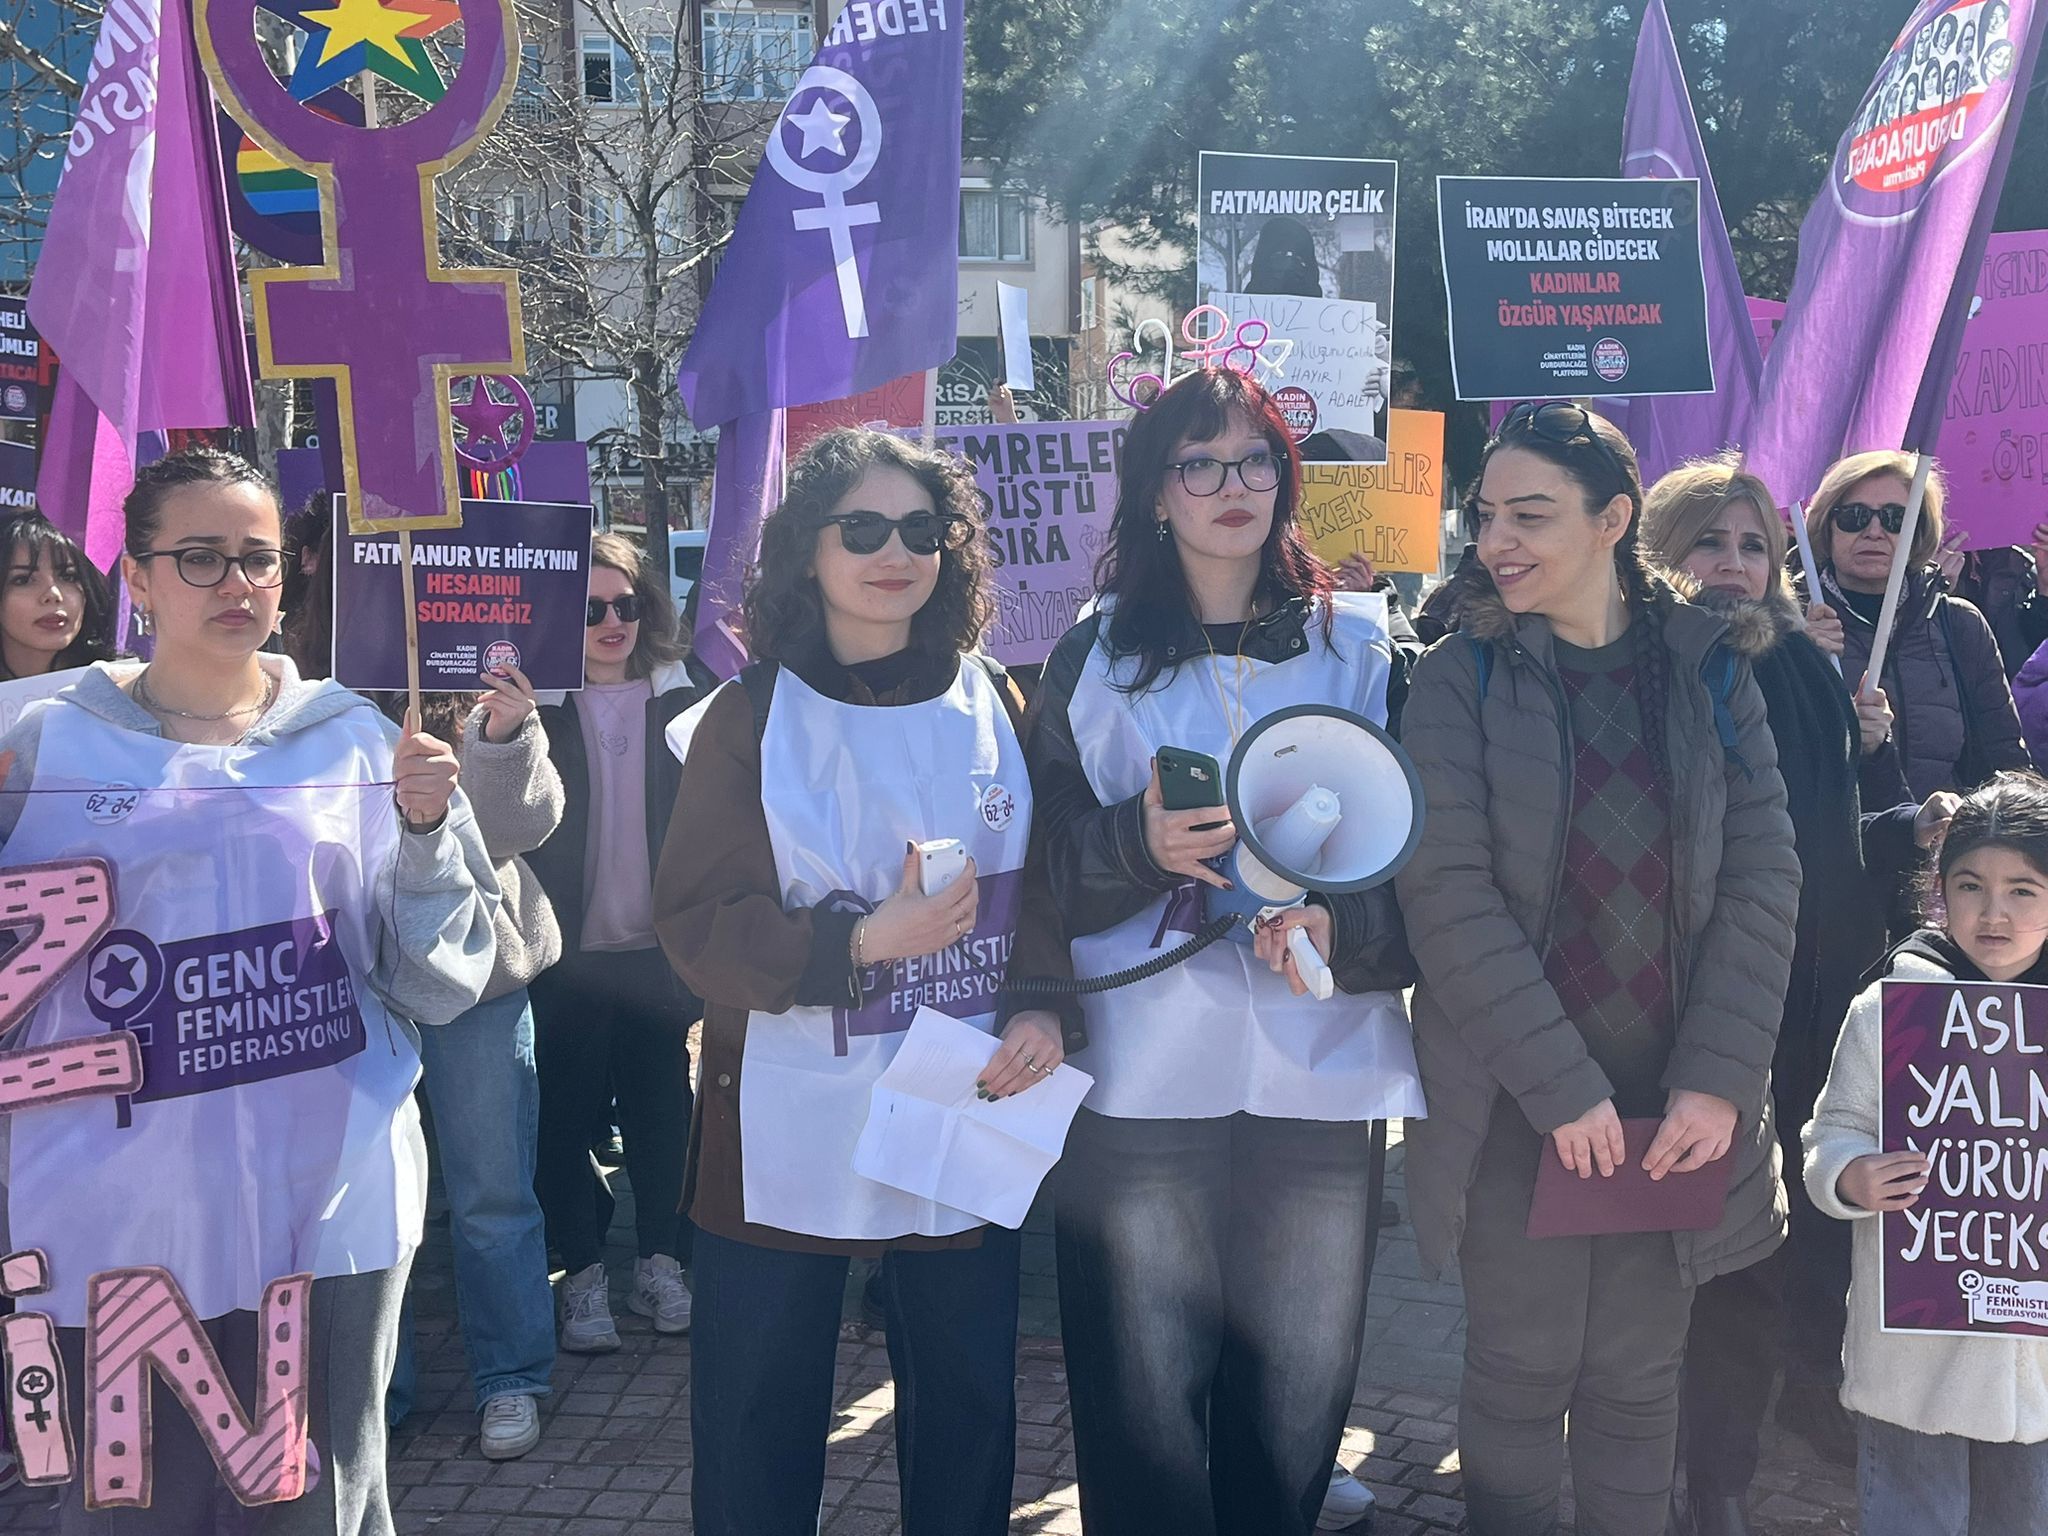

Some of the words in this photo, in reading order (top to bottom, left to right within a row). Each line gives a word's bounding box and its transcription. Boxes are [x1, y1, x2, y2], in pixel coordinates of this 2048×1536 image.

[1210, 190, 1323, 214] FATMANUR
[1325, 183, 1385, 220] ÇELİK
[1542, 206, 1600, 235] SAVAŞ
[1602, 201, 1674, 229] BİTECEK
[1487, 240, 1583, 262] MOLLALAR
[1585, 233, 1660, 261] GİDECEK
[1530, 272, 1621, 294] KADINLAR
[1498, 299, 1557, 326] ÖZGÜR
[1559, 304, 1662, 332] YAŞAYACAK
[1276, 393, 1307, 402] KADIN
[475, 546, 501, 569] VE
[426, 573, 521, 597] HESABINI
[418, 598, 532, 625] SORACAĞIZ
[174, 941, 297, 1003] GENÇ
[179, 1014, 351, 1076] FEDERASYONU
[1986, 1284, 2020, 1296] GENÇ
